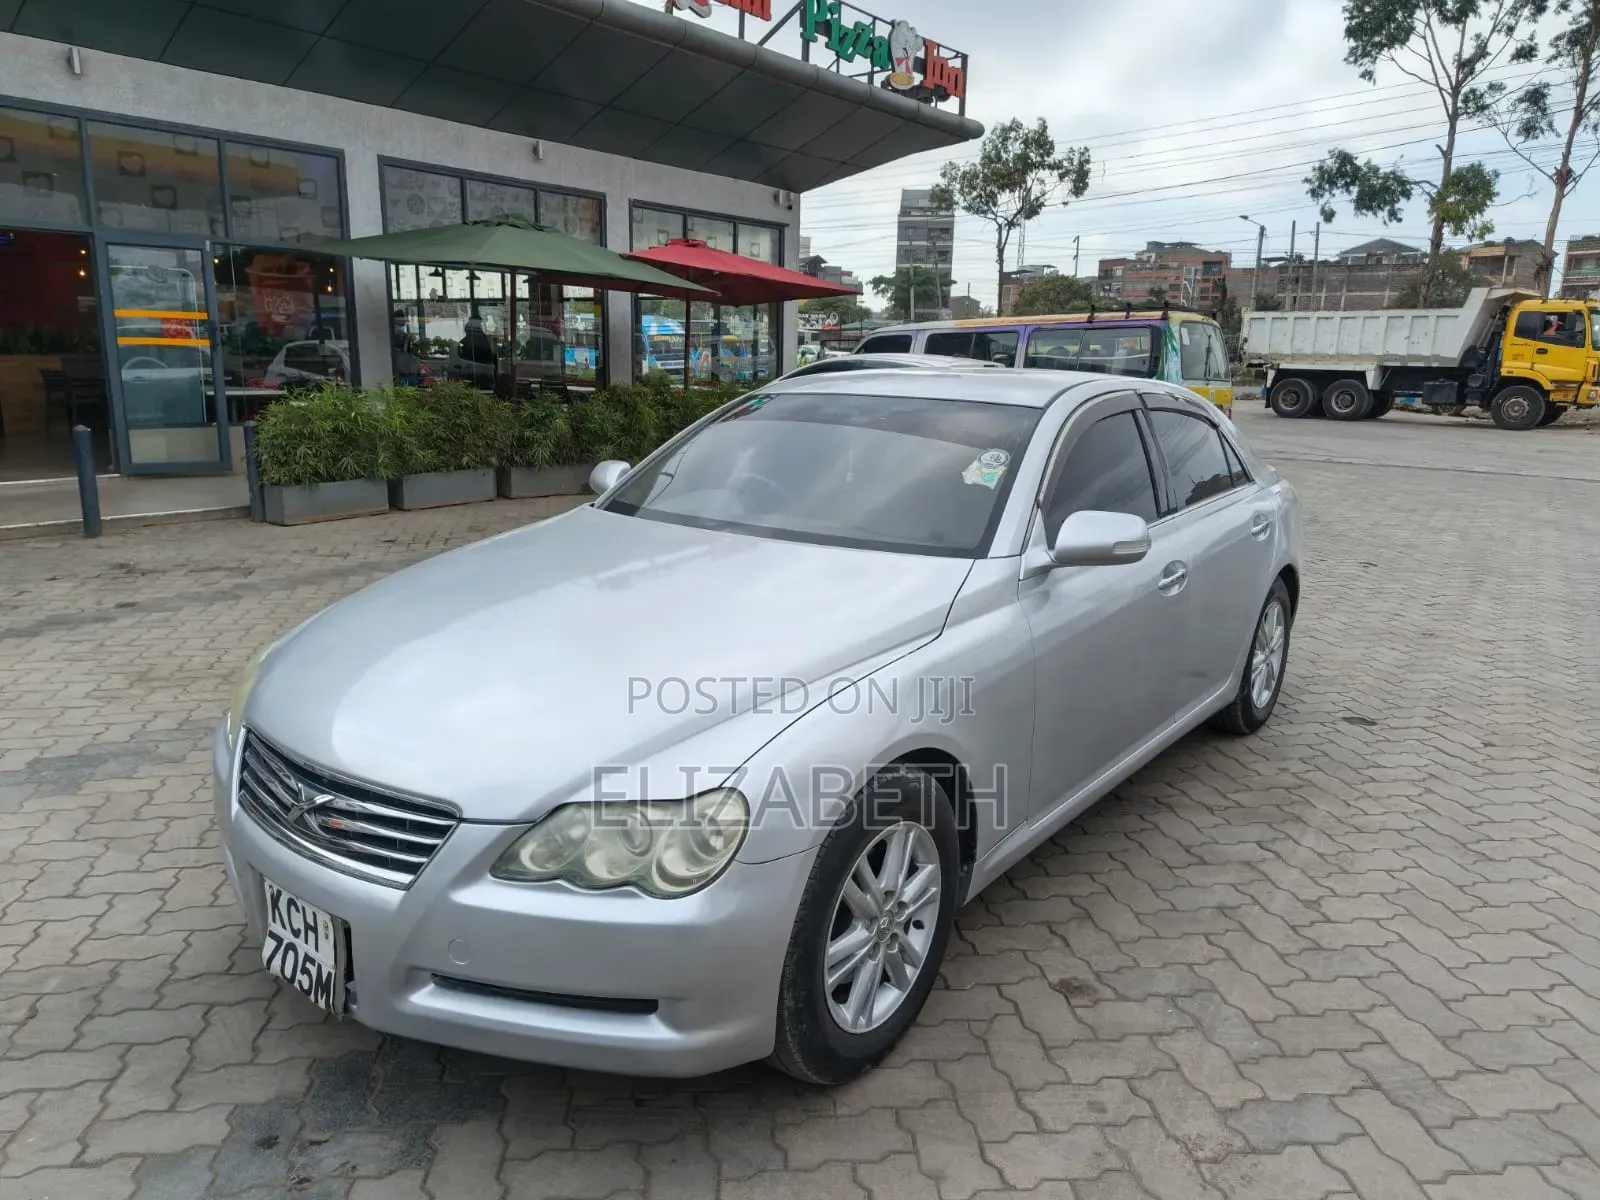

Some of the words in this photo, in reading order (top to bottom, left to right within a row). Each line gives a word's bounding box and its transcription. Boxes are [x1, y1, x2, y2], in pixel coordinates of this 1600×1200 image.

[800, 0, 892, 70] Pizza
[922, 38, 964, 98] Inn
[268, 885, 320, 953] KCH
[265, 929, 333, 1012] 705M
